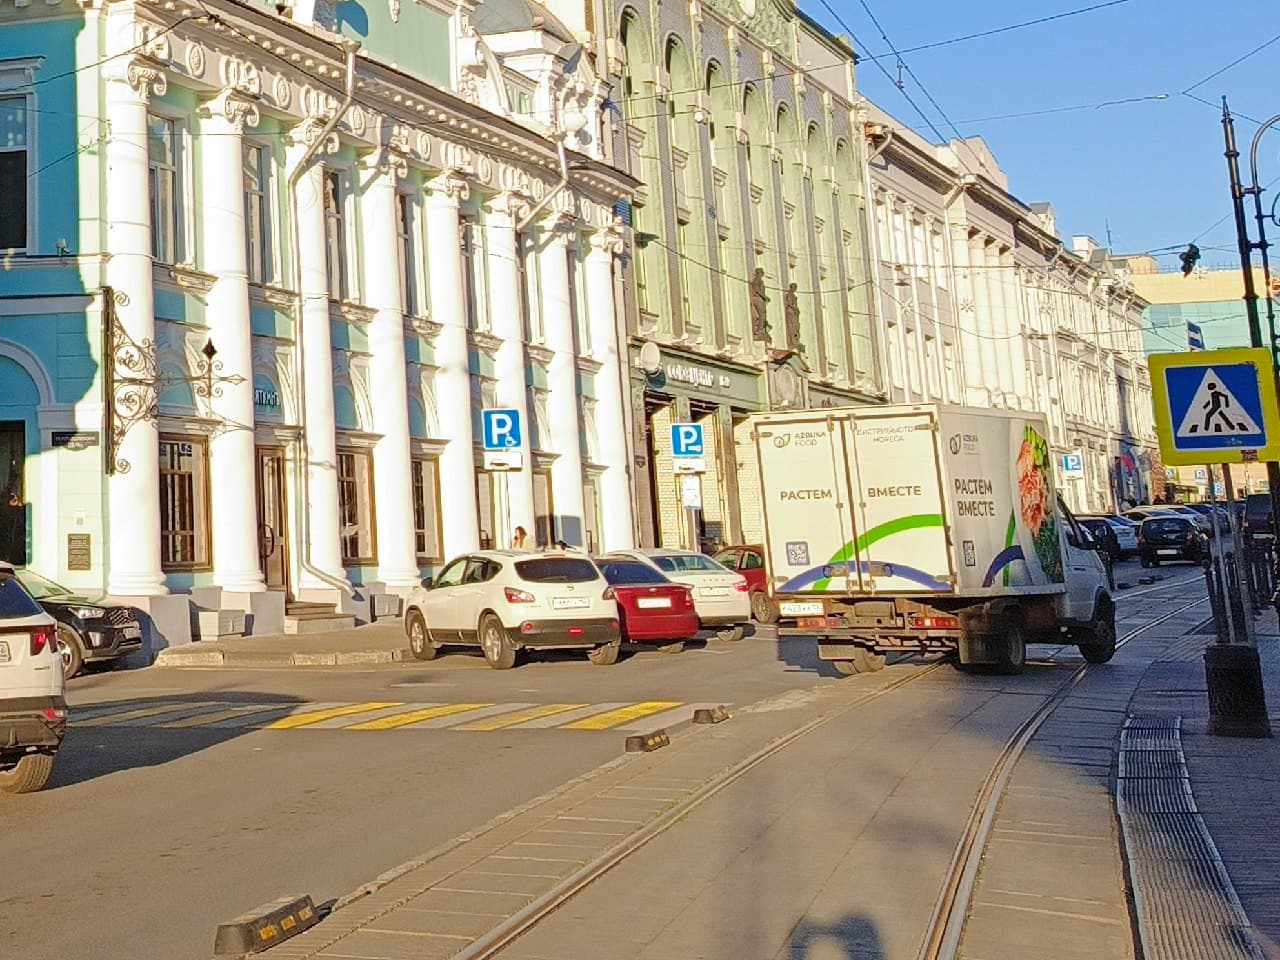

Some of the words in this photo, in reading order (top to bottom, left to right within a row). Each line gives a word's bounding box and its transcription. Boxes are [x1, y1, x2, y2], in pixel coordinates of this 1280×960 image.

[491, 413, 513, 445] P
[679, 426, 698, 452] P
[780, 489, 833, 501] РАСТЕМ
[867, 485, 922, 498] ВМЕСТЕ
[954, 478, 993, 495] РАСТЕМ
[957, 500, 996, 517] ВМЕСТЕ
